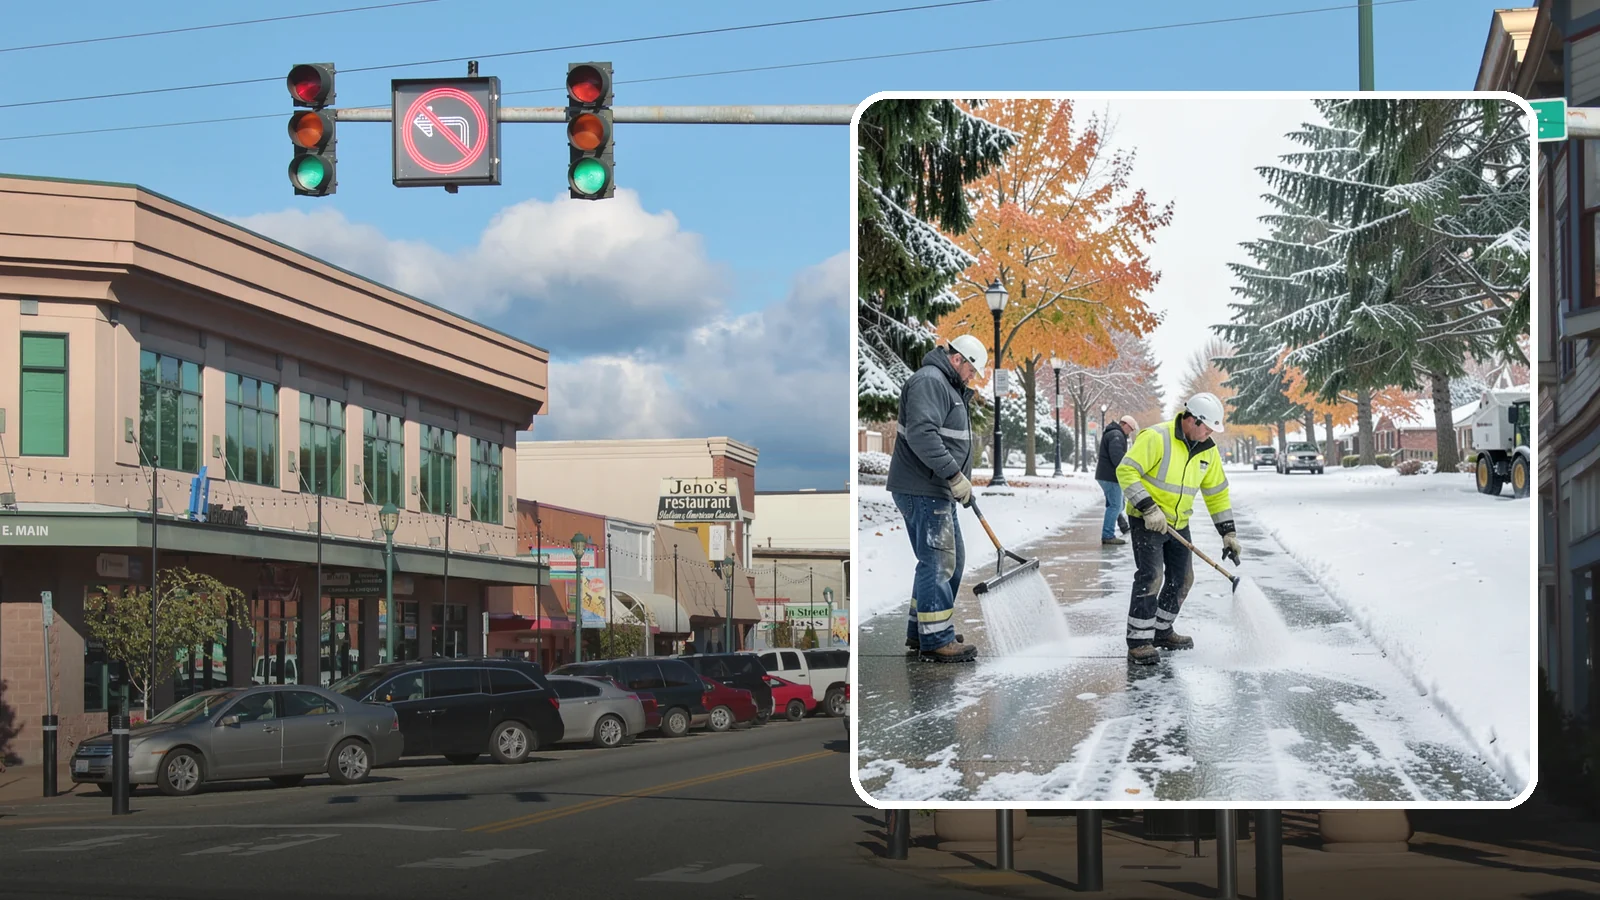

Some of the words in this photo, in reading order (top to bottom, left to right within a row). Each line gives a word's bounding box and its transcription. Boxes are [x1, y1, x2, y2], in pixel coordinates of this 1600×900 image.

[670, 480, 728, 494] Jeno's
[665, 497, 731, 509] restaurant
[658, 510, 682, 520] Italian
[686, 509, 714, 519] American
[715, 509, 737, 519] Cuisine
[2, 525, 13, 536] E.
[15, 525, 49, 536] MAIN
[786, 607, 795, 616] in
[797, 607, 829, 616] Street
[791, 619, 824, 627] lass
